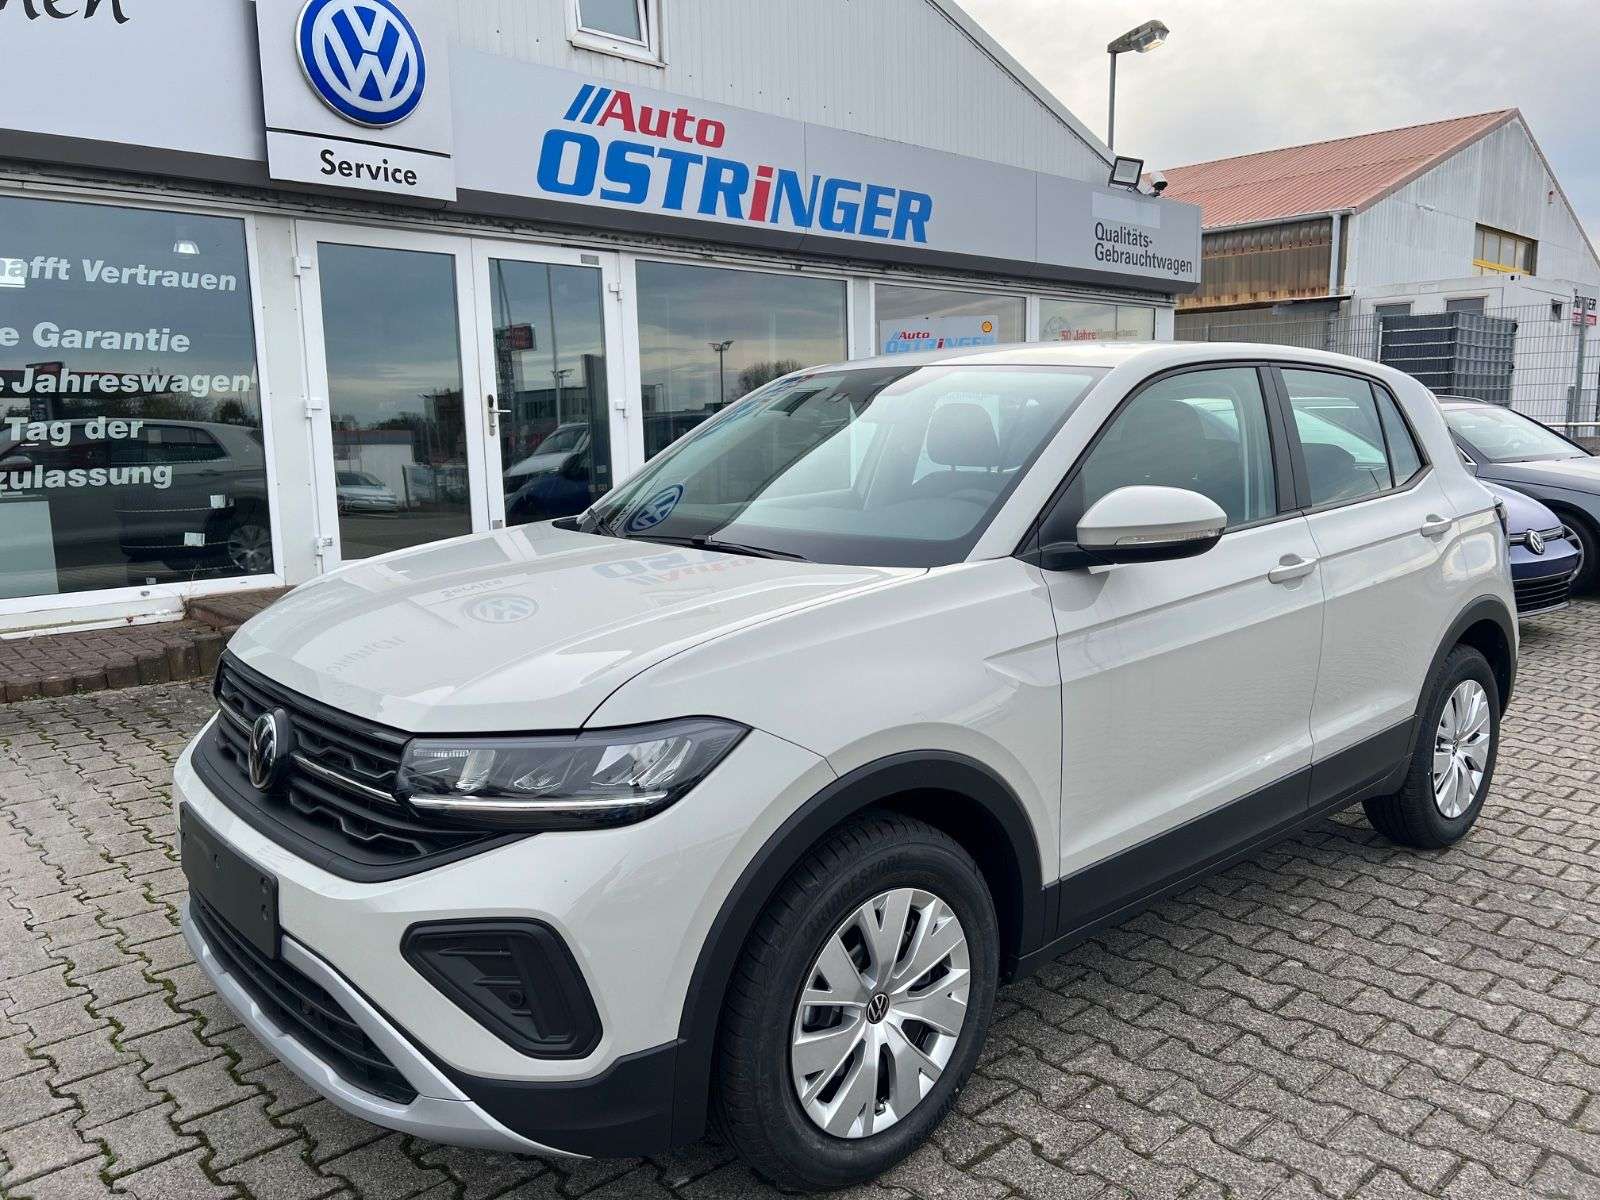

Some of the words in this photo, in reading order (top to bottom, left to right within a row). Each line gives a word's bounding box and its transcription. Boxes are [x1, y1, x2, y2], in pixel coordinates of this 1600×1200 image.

[319, 149, 418, 186] Service
[1095, 222, 1153, 248] Qualitäts-
[1095, 242, 1193, 276] Gebrauchtwagen
[82, 259, 237, 291] Vertrauen
[32, 321, 190, 353] Garantie
[898, 330, 930, 341] Auto
[1074, 329, 1096, 341] Jahre
[11, 368, 250, 397] Jahreswagen
[4, 417, 71, 447] Tag
[84, 416, 143, 440] der
